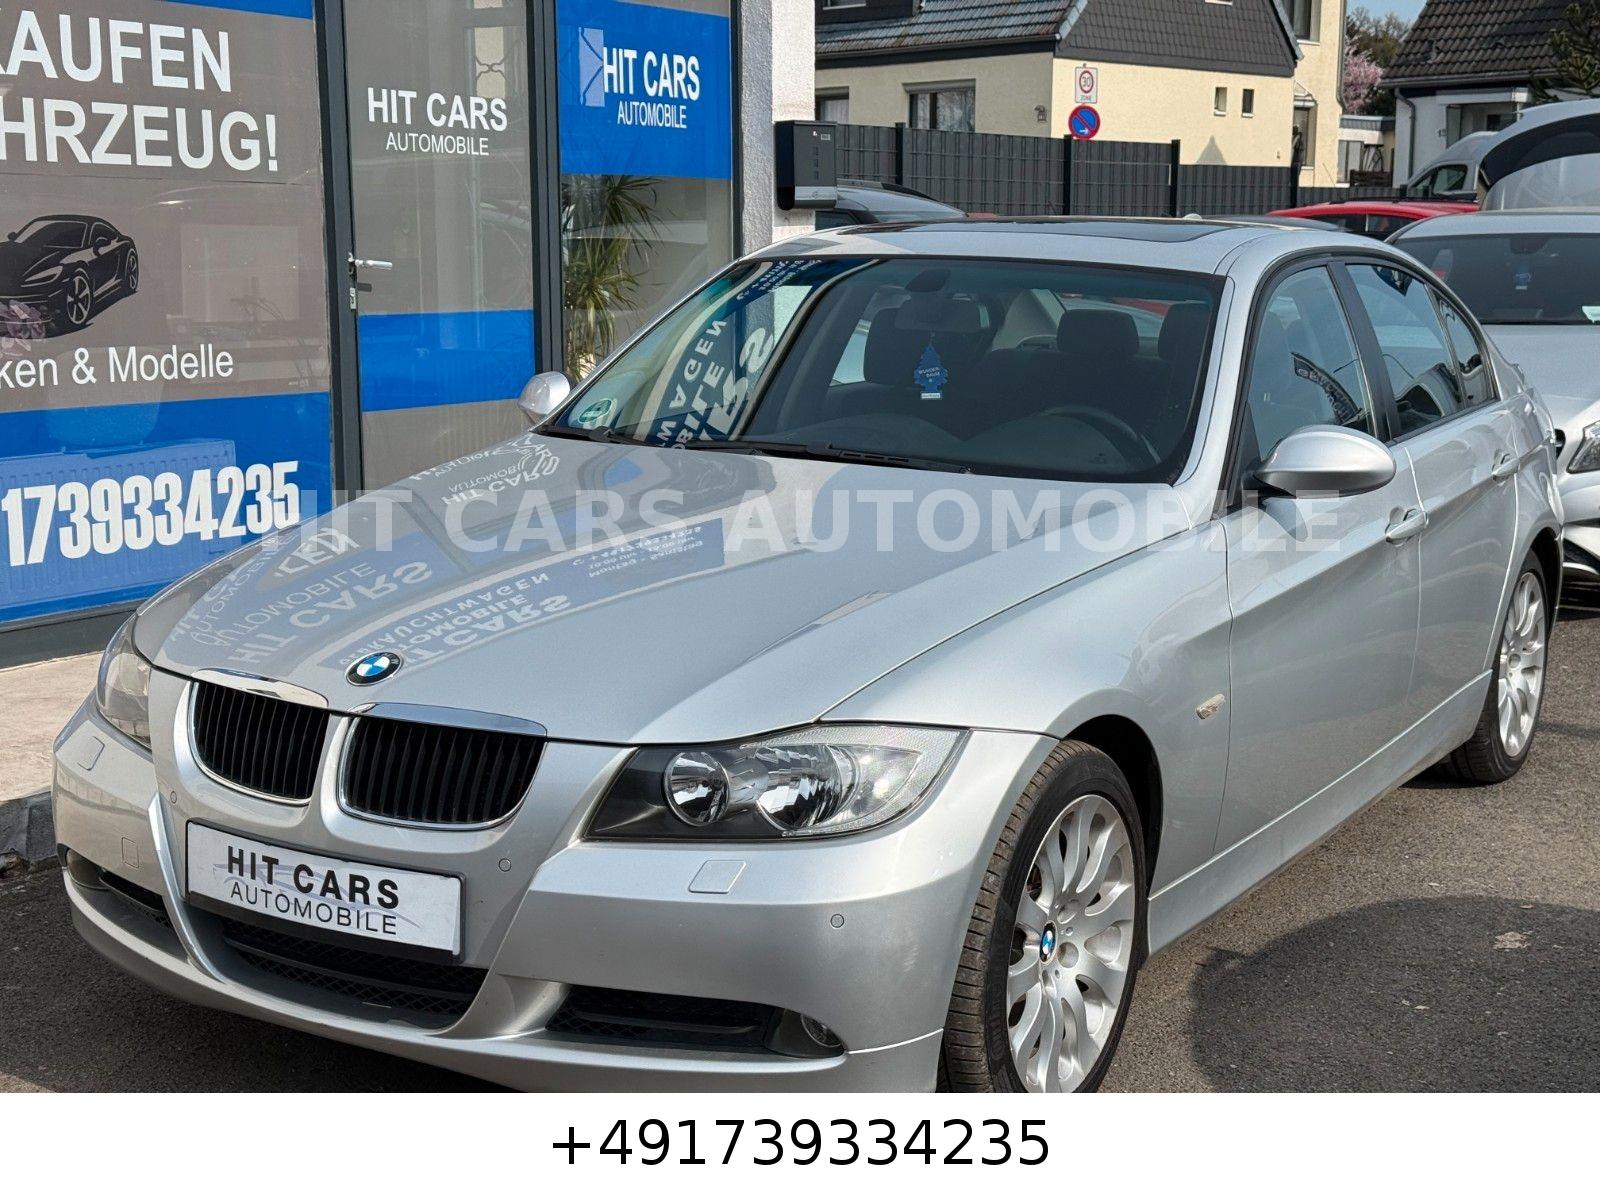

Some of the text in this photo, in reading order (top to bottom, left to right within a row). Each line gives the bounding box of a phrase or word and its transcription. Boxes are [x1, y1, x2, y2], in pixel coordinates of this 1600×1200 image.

[0, 8, 232, 92] AUFEN
[603, 46, 700, 101] HIT CARS
[1082, 76, 1091, 87] 30
[367, 87, 508, 132] HIT CARS
[617, 100, 688, 129] AUTOMOBILE
[385, 131, 490, 156] AUTOMOBILE
[71, 347, 98, 385] &
[108, 343, 234, 383] Modelle
[2, 460, 300, 567] 1739334235
[227, 845, 400, 909] HIT CARS
[230, 881, 397, 935] AUTOMOBILE
